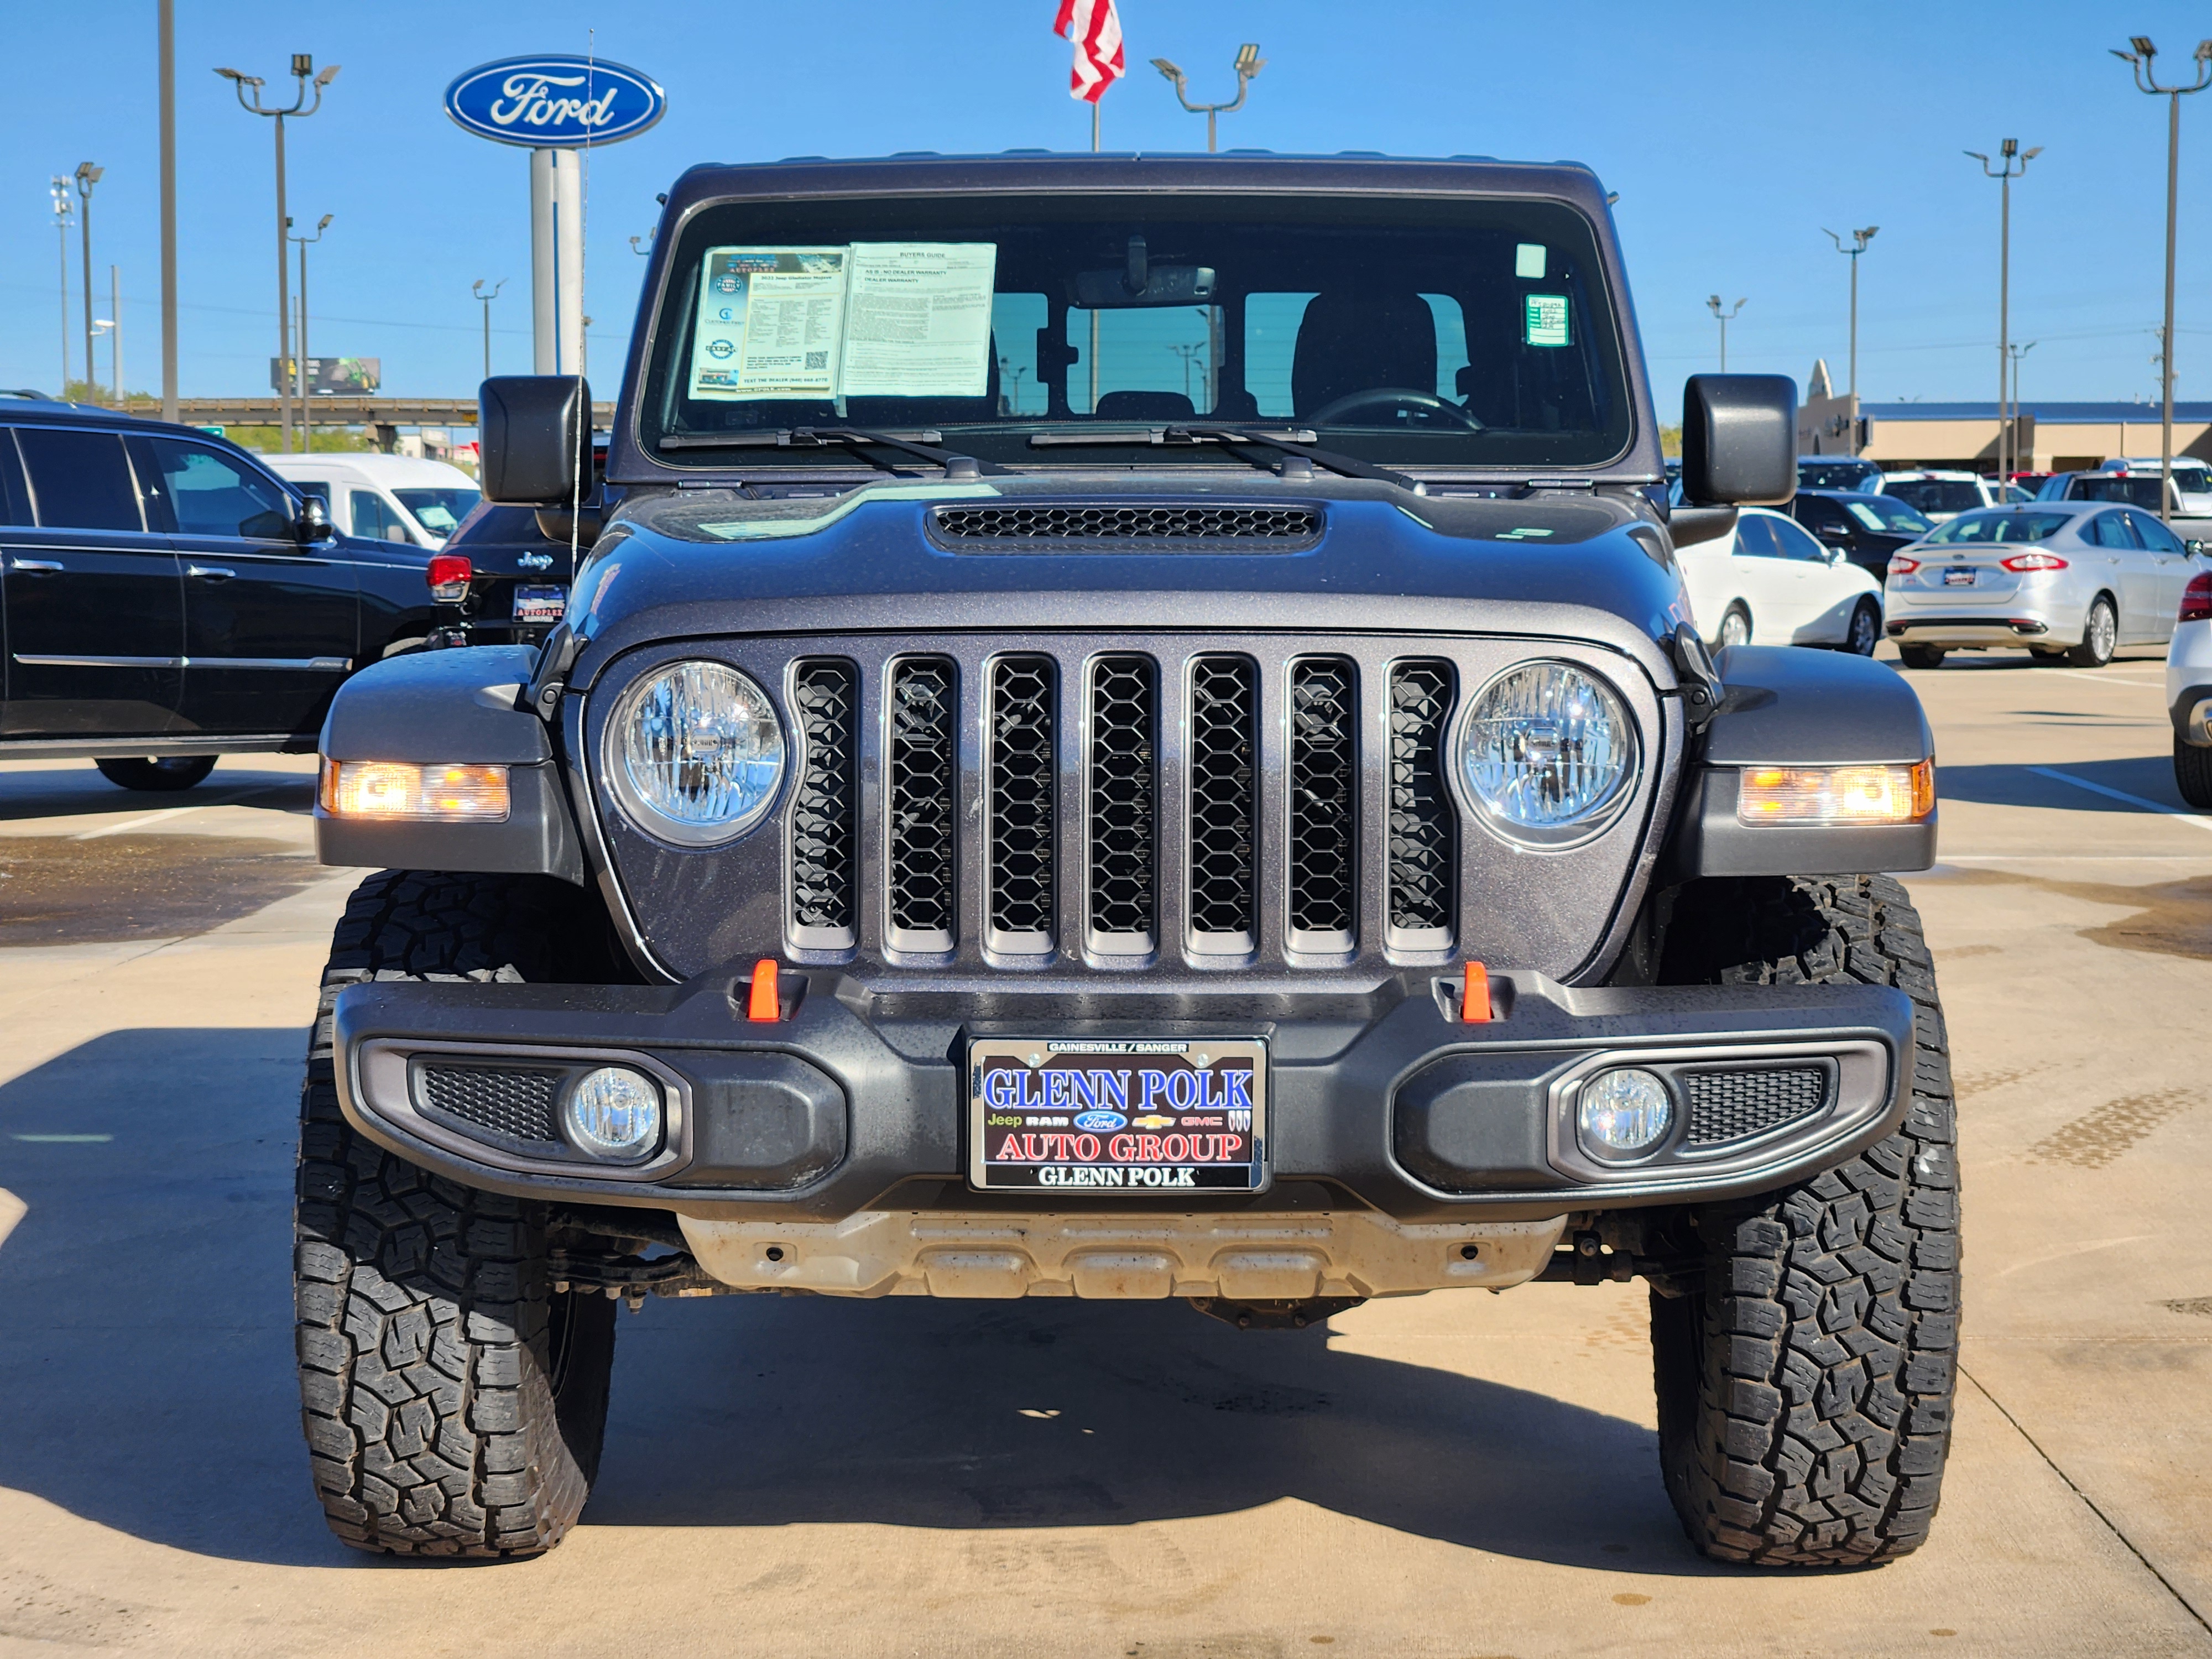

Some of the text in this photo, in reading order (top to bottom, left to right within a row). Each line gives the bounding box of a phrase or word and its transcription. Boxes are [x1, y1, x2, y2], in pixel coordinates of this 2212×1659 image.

[491, 73, 618, 126] Ford
[518, 551, 554, 571] Jeep
[984, 1068, 1253, 1110] GLENN POLK
[987, 1113, 1223, 1129] Jeep RAM Ford GMC
[996, 1134, 1243, 1161] AUTO GROUP
[1039, 1166, 1196, 1187] GLENN POLK
